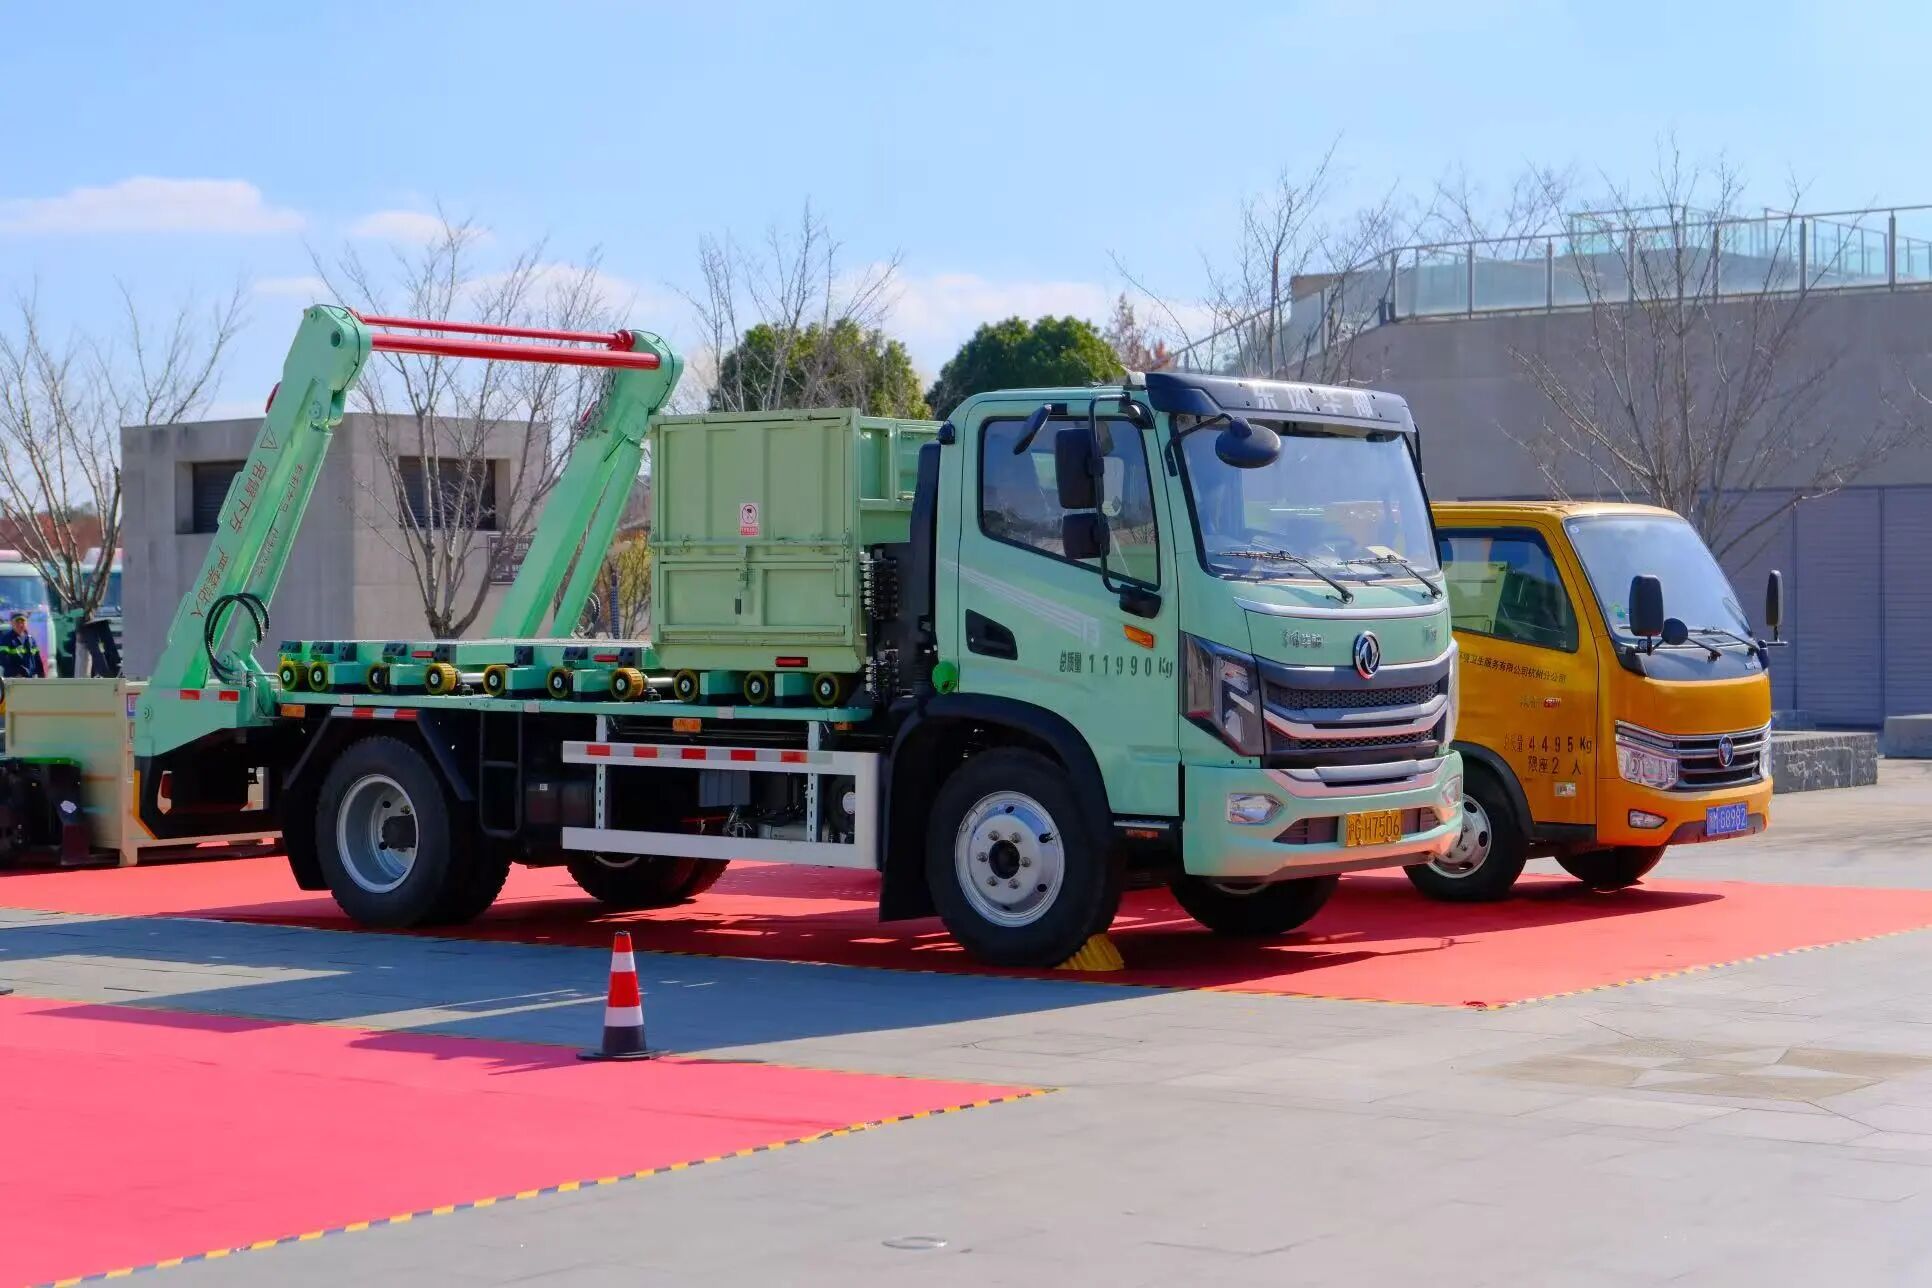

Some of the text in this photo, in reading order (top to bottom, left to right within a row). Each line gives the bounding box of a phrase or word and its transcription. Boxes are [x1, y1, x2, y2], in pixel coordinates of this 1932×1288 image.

[1059, 650, 1082, 674] 总质量
[1089, 654, 1152, 677] 11990
[1528, 735, 1574, 753] 4495
